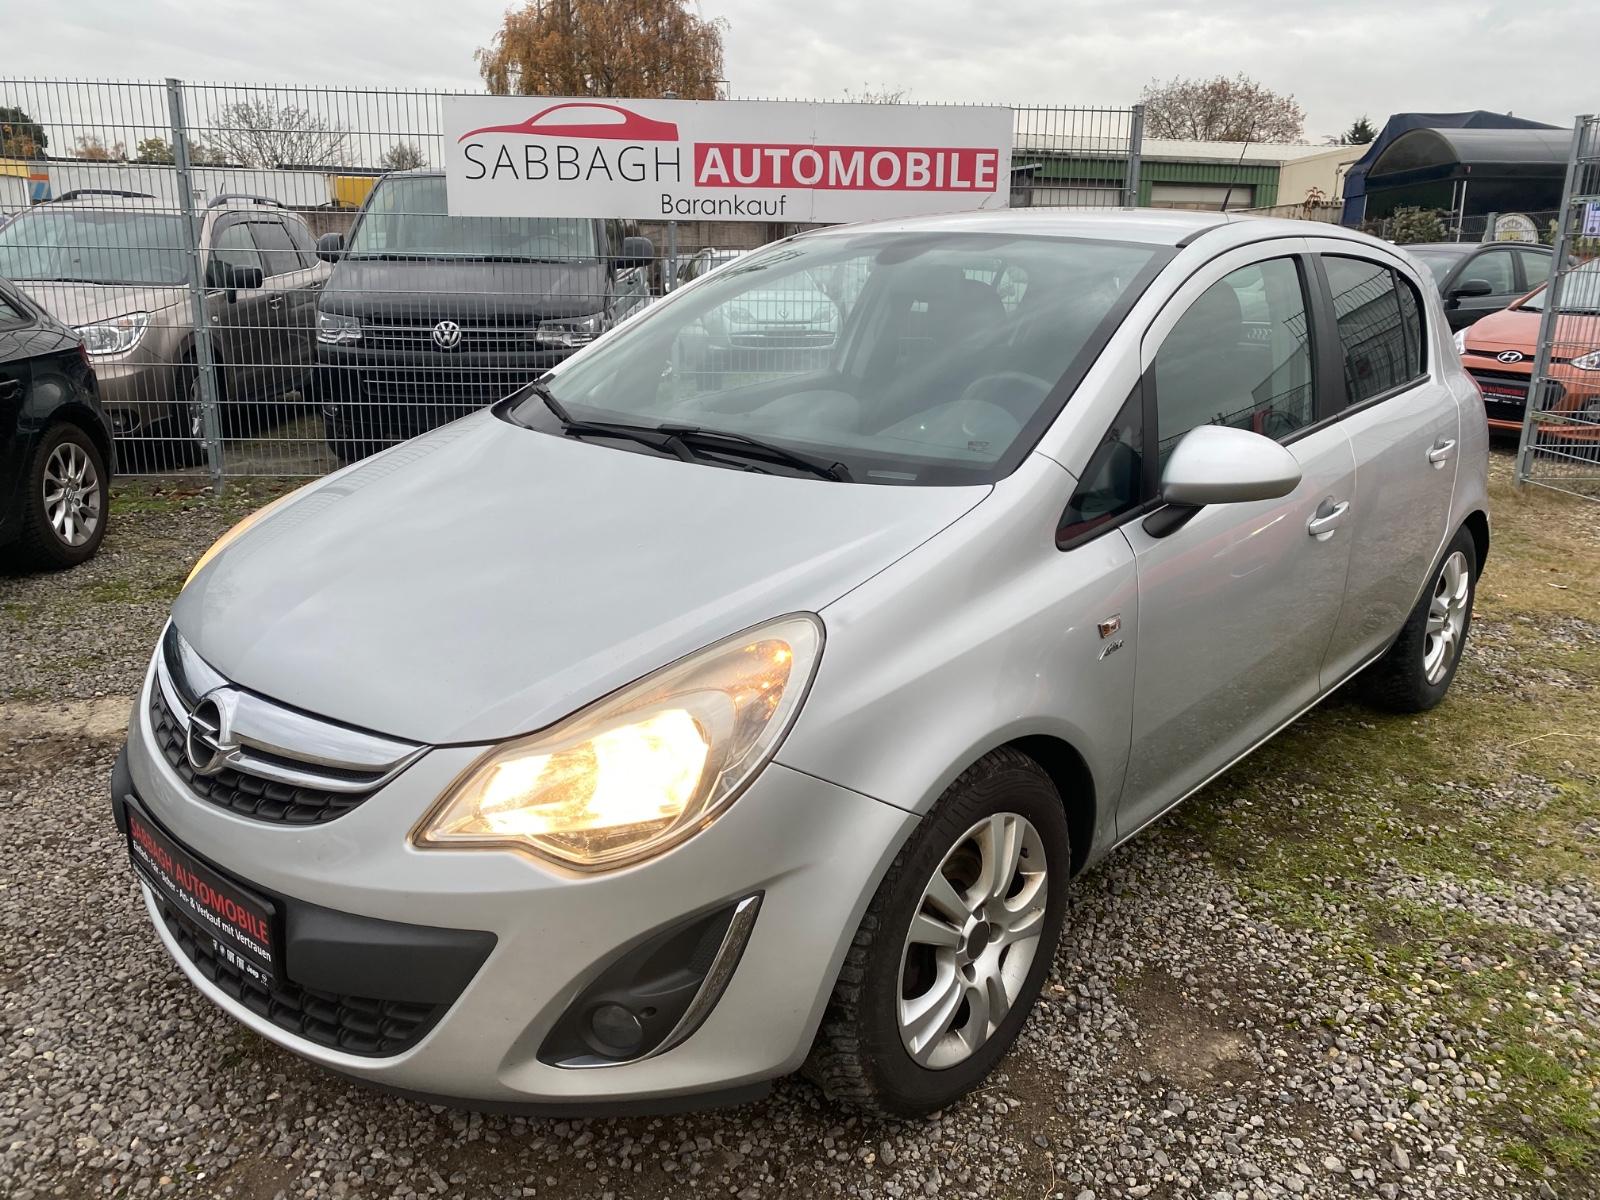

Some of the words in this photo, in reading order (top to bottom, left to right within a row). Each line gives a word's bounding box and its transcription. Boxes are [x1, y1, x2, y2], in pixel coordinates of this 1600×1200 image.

[464, 143, 680, 183] SABBAGH
[698, 147, 997, 189] AUTOMOBILE
[661, 193, 788, 217] Barankauf
[130, 817, 174, 876] SABBAGH
[176, 863, 270, 945] AUTOMOBILE
[196, 902, 221, 928] Verkauf
[221, 922, 235, 938] mit
[234, 928, 272, 963] Vertrauen
